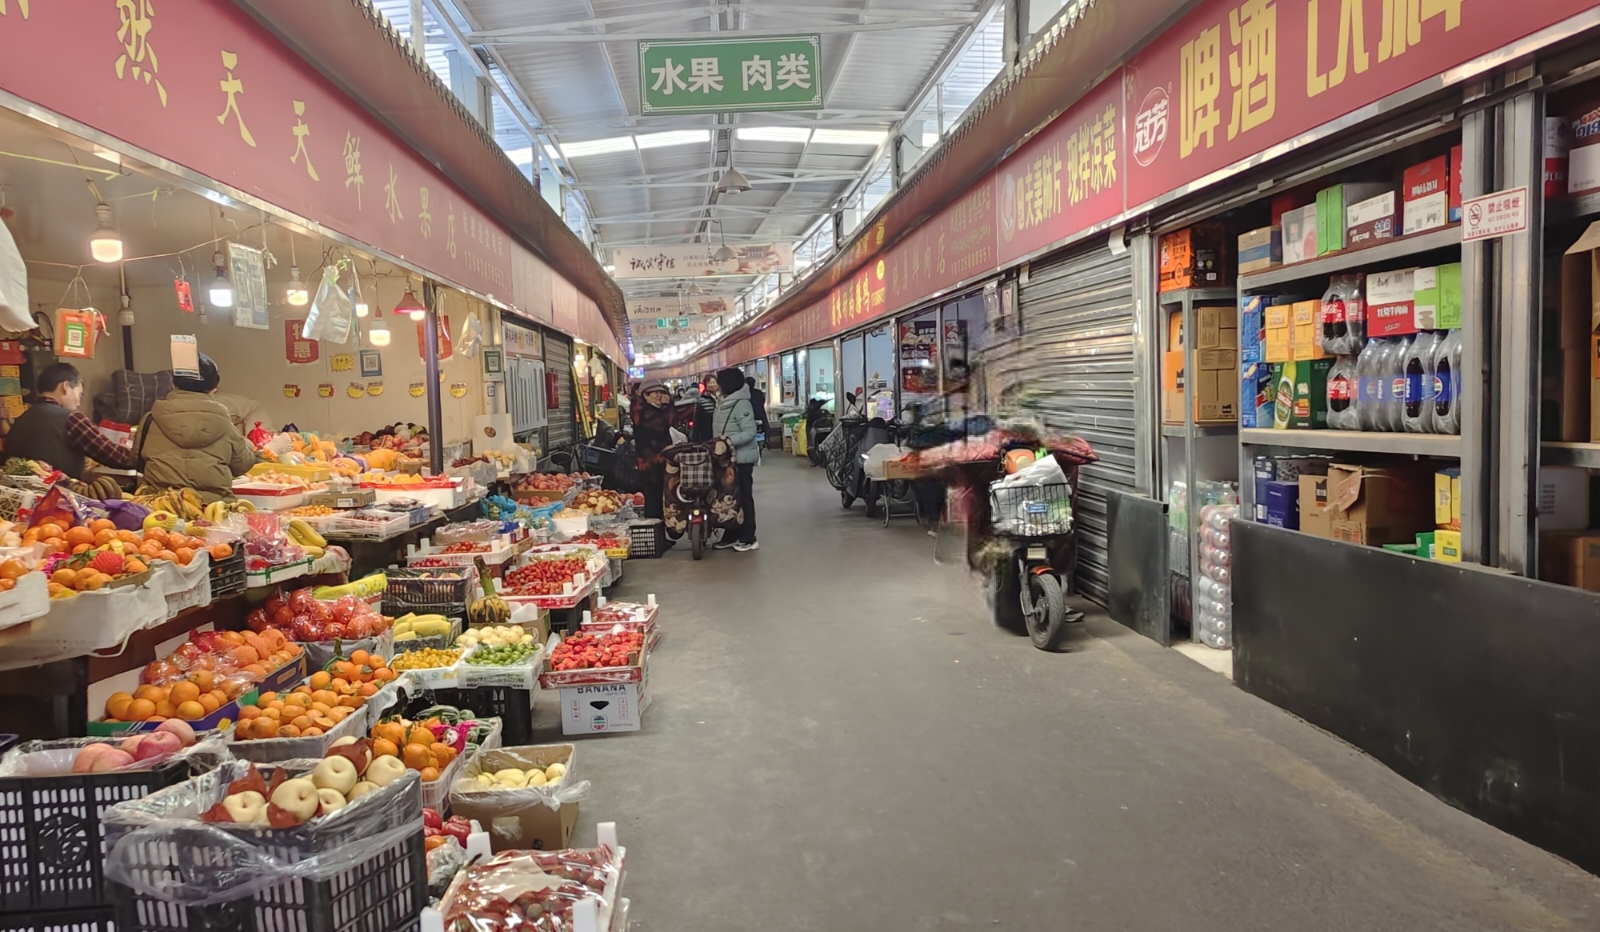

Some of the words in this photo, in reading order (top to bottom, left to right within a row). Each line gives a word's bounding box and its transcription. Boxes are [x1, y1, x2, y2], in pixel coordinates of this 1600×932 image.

[650, 57, 724, 96] 水果
[741, 52, 813, 92] 肉类
[1180, 0, 1277, 159] 啤酒
[0, 0, 458, 259] 然天天鲜水果店
[1135, 99, 1168, 154] 冠芳
[1025, 142, 1062, 230] 夫妻肺片
[1066, 103, 1117, 208] 现拌凉菜
[1488, 196, 1520, 214] 禁止吸烟
[577, 684, 626, 694] BANANA
